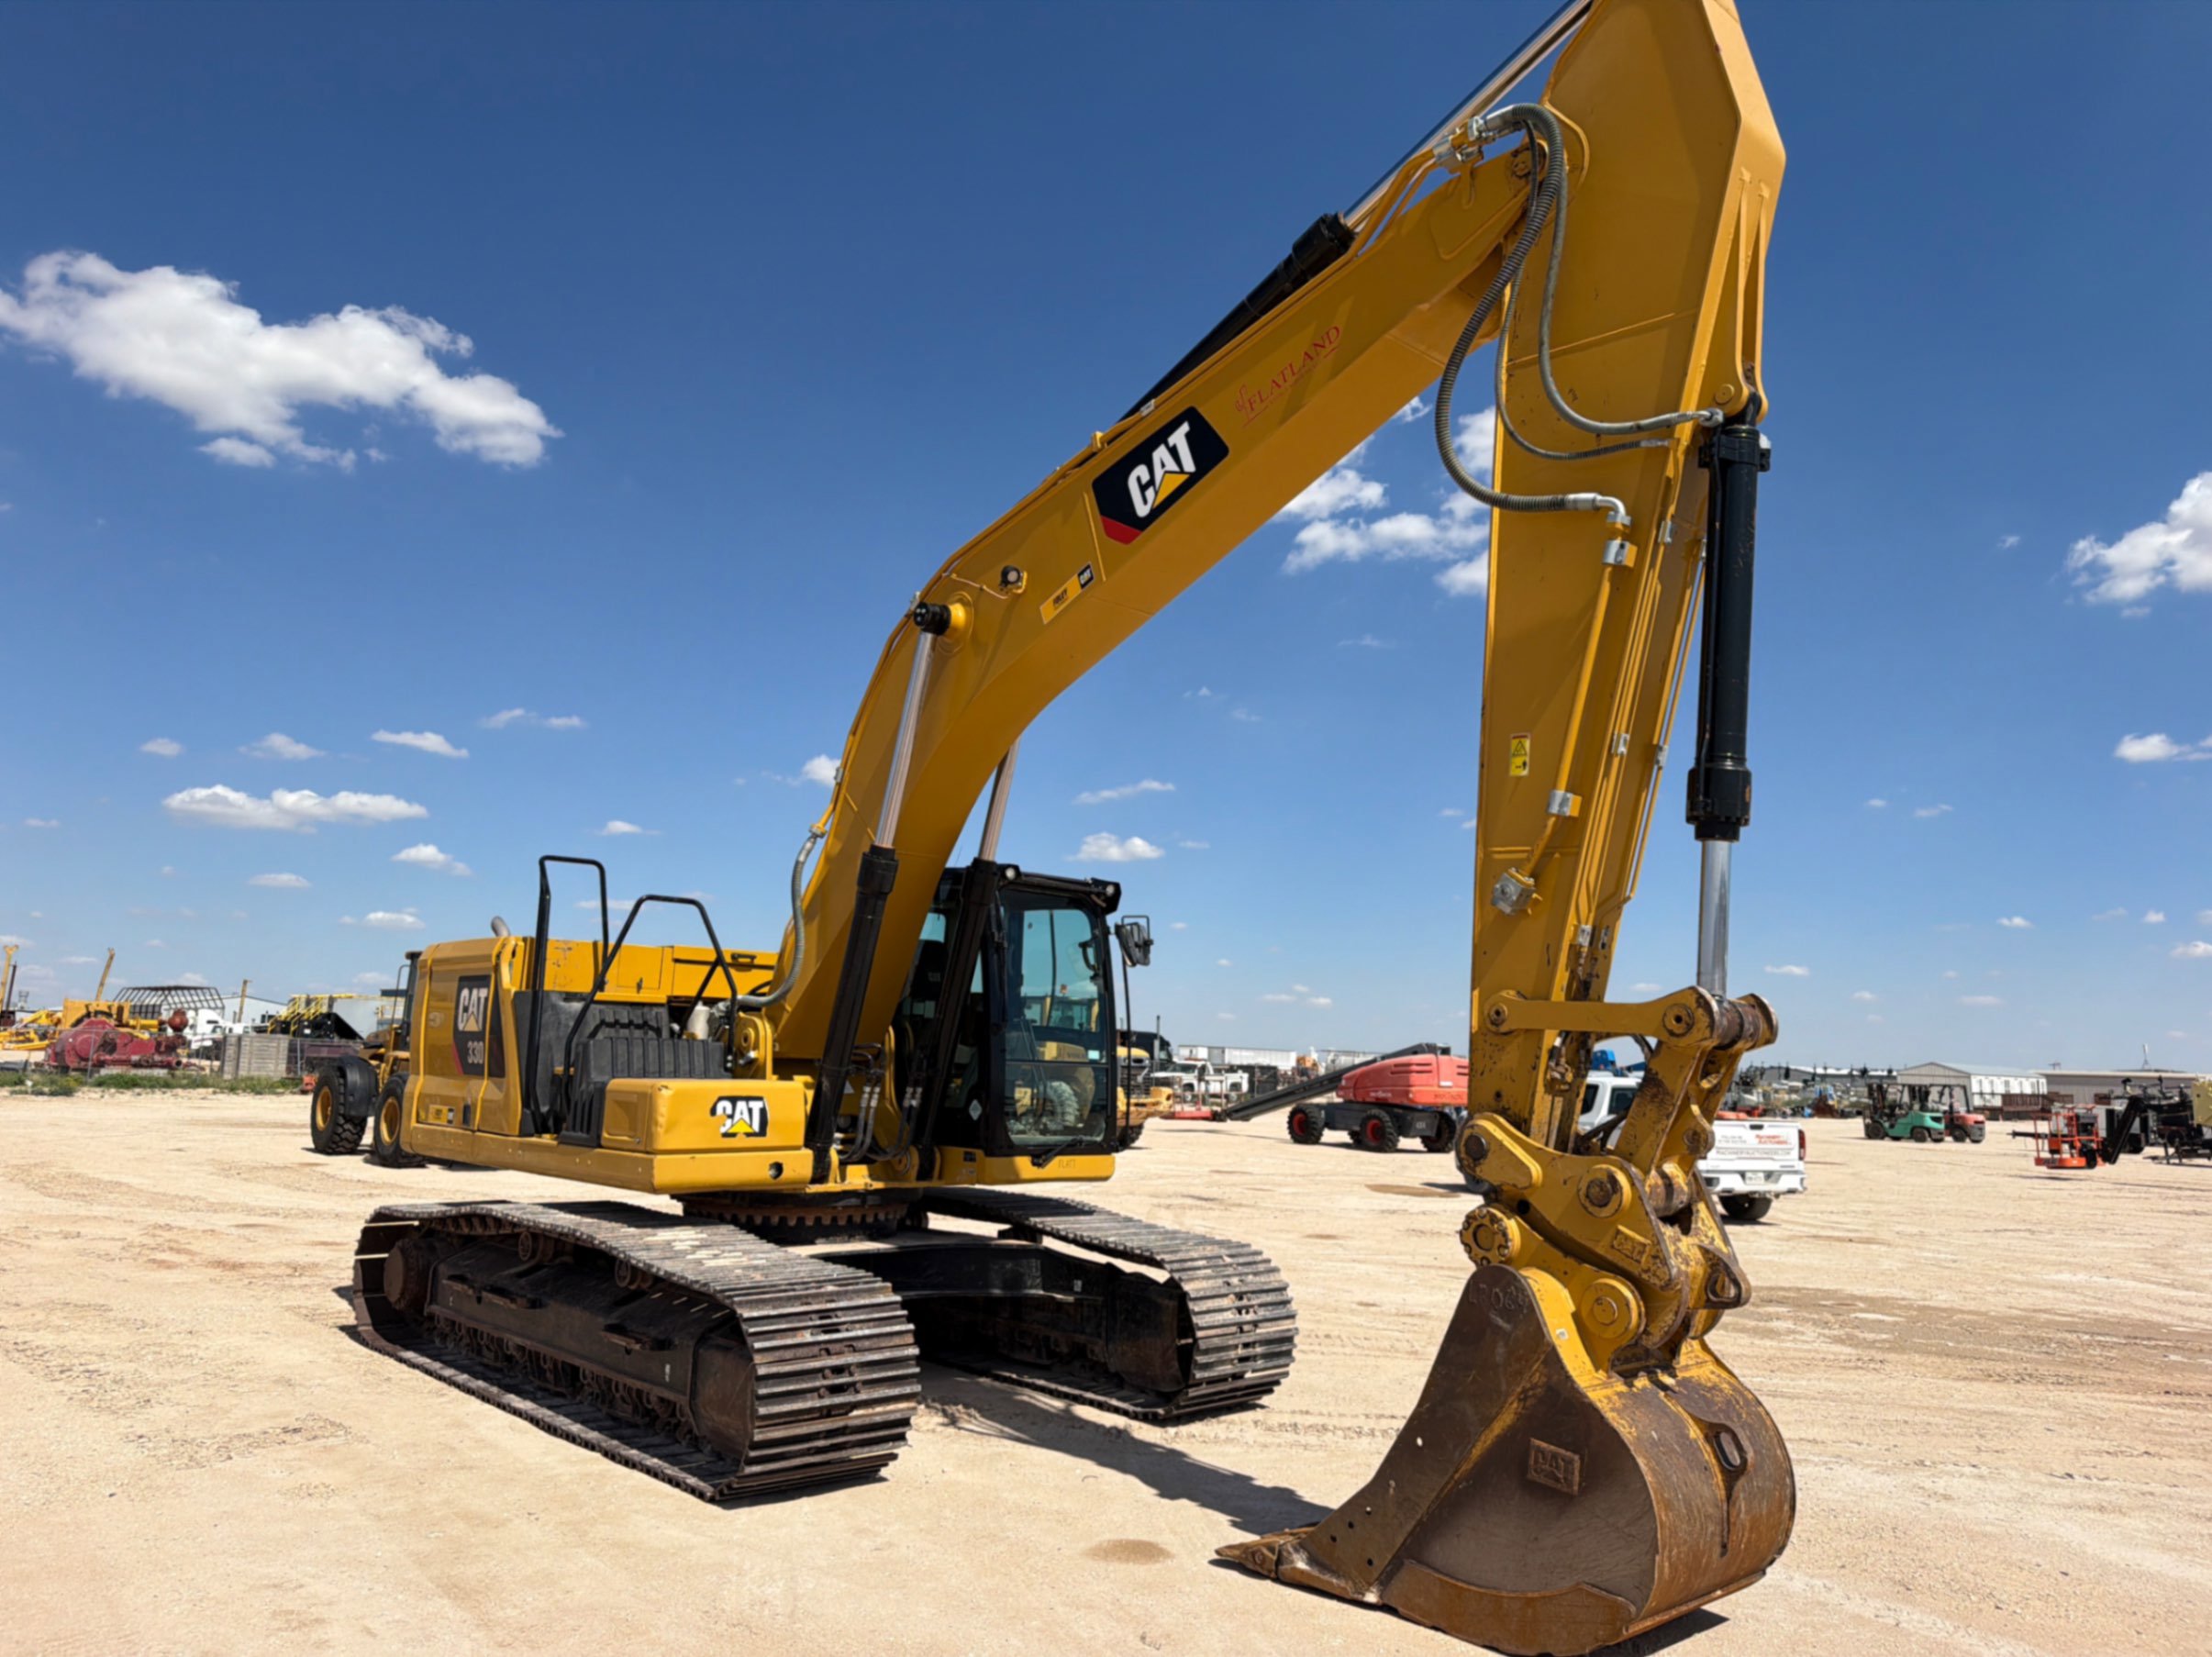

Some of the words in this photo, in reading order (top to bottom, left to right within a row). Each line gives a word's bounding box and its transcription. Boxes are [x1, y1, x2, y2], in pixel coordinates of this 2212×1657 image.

[1248, 326, 1339, 412] FLATLAND
[1128, 420, 1196, 518] CAT
[457, 987, 488, 1031] CAT
[467, 1040, 484, 1064] 330
[716, 1099, 763, 1133] CAT
